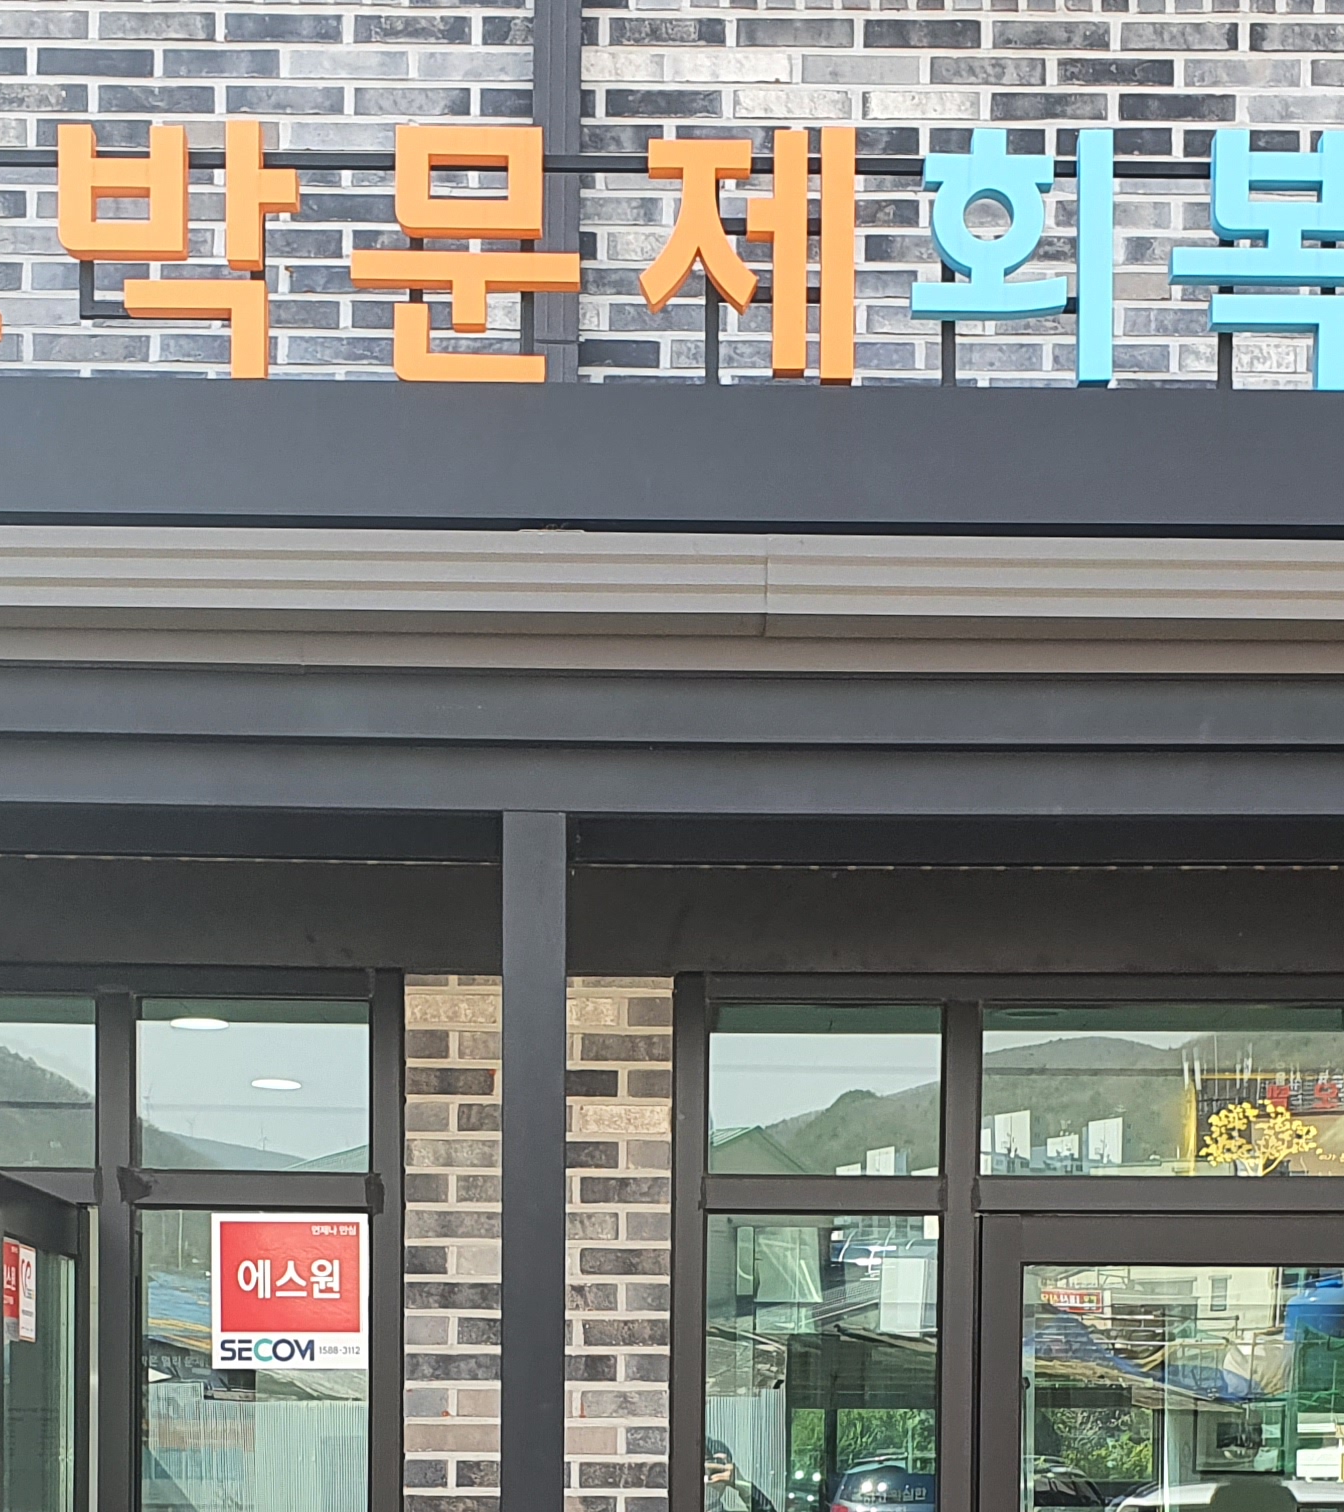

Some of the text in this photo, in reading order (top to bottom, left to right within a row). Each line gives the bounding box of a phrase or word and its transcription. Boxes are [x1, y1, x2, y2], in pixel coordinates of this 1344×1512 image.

[311, 1224, 357, 1236] 언제나 안심
[237, 1258, 341, 1300] 에스원
[220, 1338, 315, 1362] SECOM
[318, 1345, 361, 1355] 1588-3112
